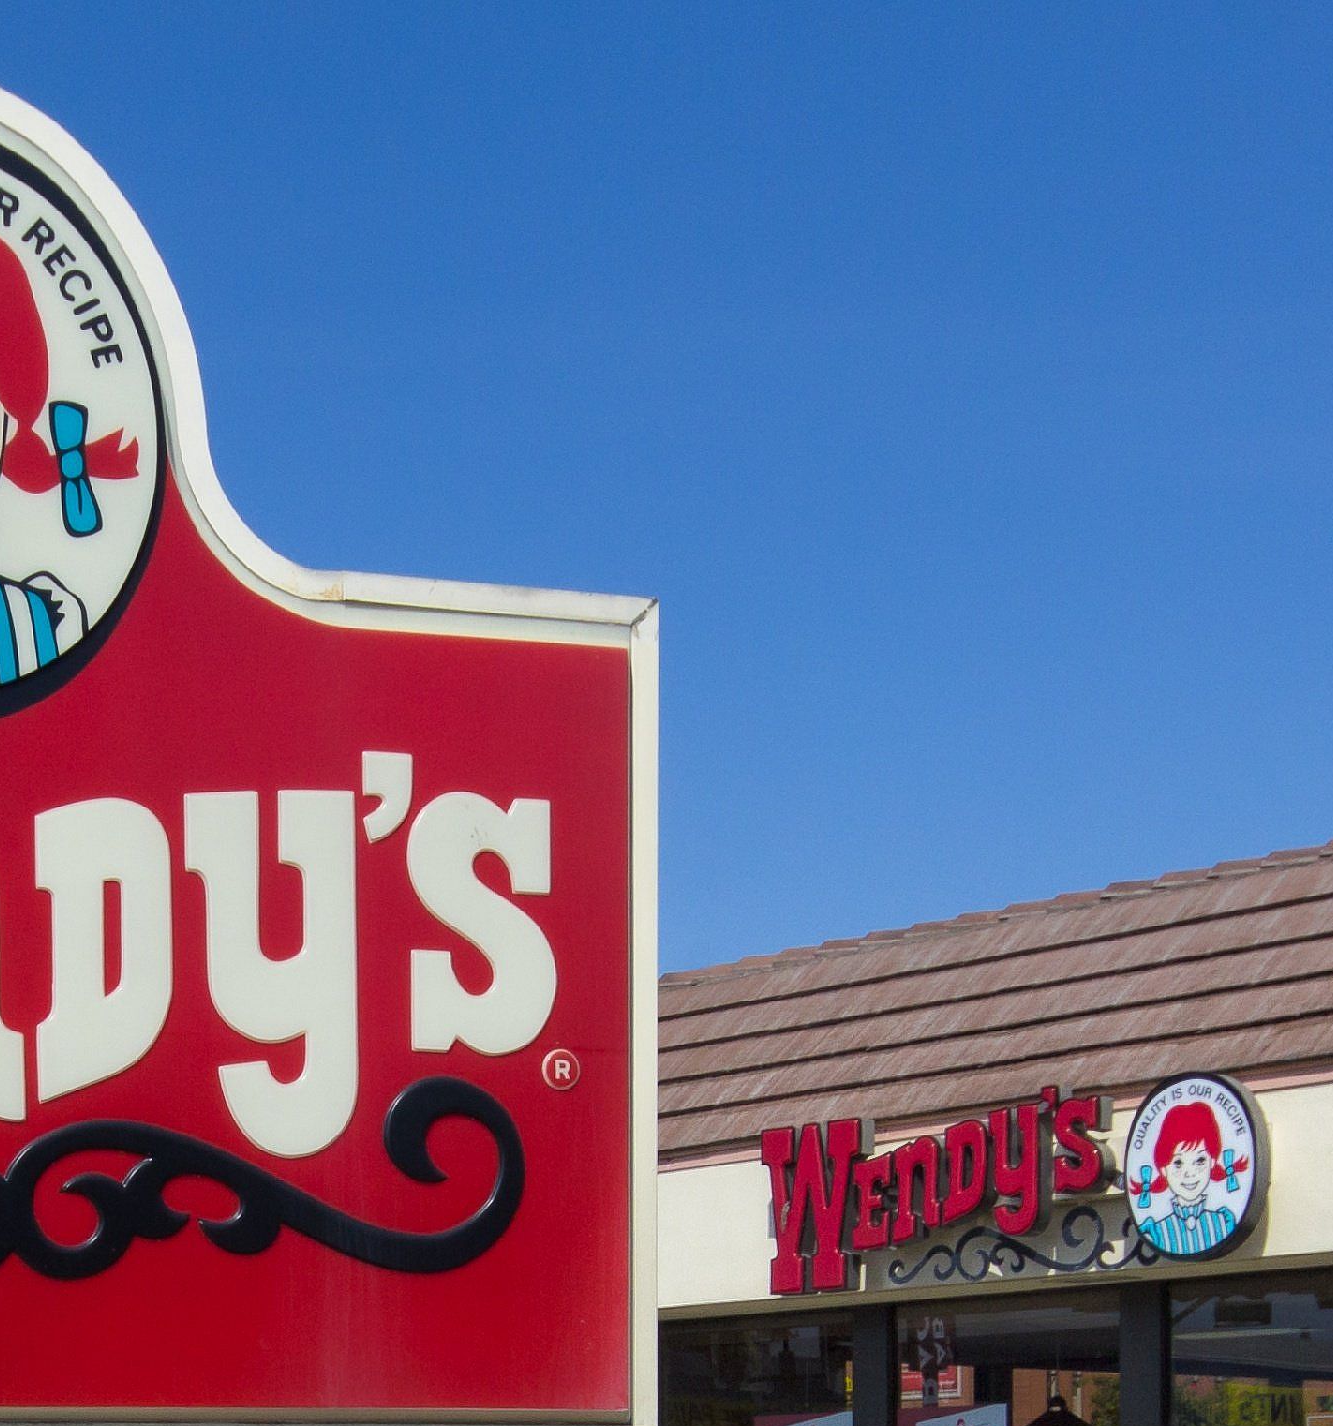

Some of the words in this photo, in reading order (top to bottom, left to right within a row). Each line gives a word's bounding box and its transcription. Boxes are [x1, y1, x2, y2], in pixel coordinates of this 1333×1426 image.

[22, 217, 124, 369] RECIPE
[1134, 1096, 1167, 1150] QUALITY
[1172, 1088, 1183, 1101] IS
[1188, 1084, 1212, 1097] OUR
[1215, 1092, 1246, 1137] RECIPE
